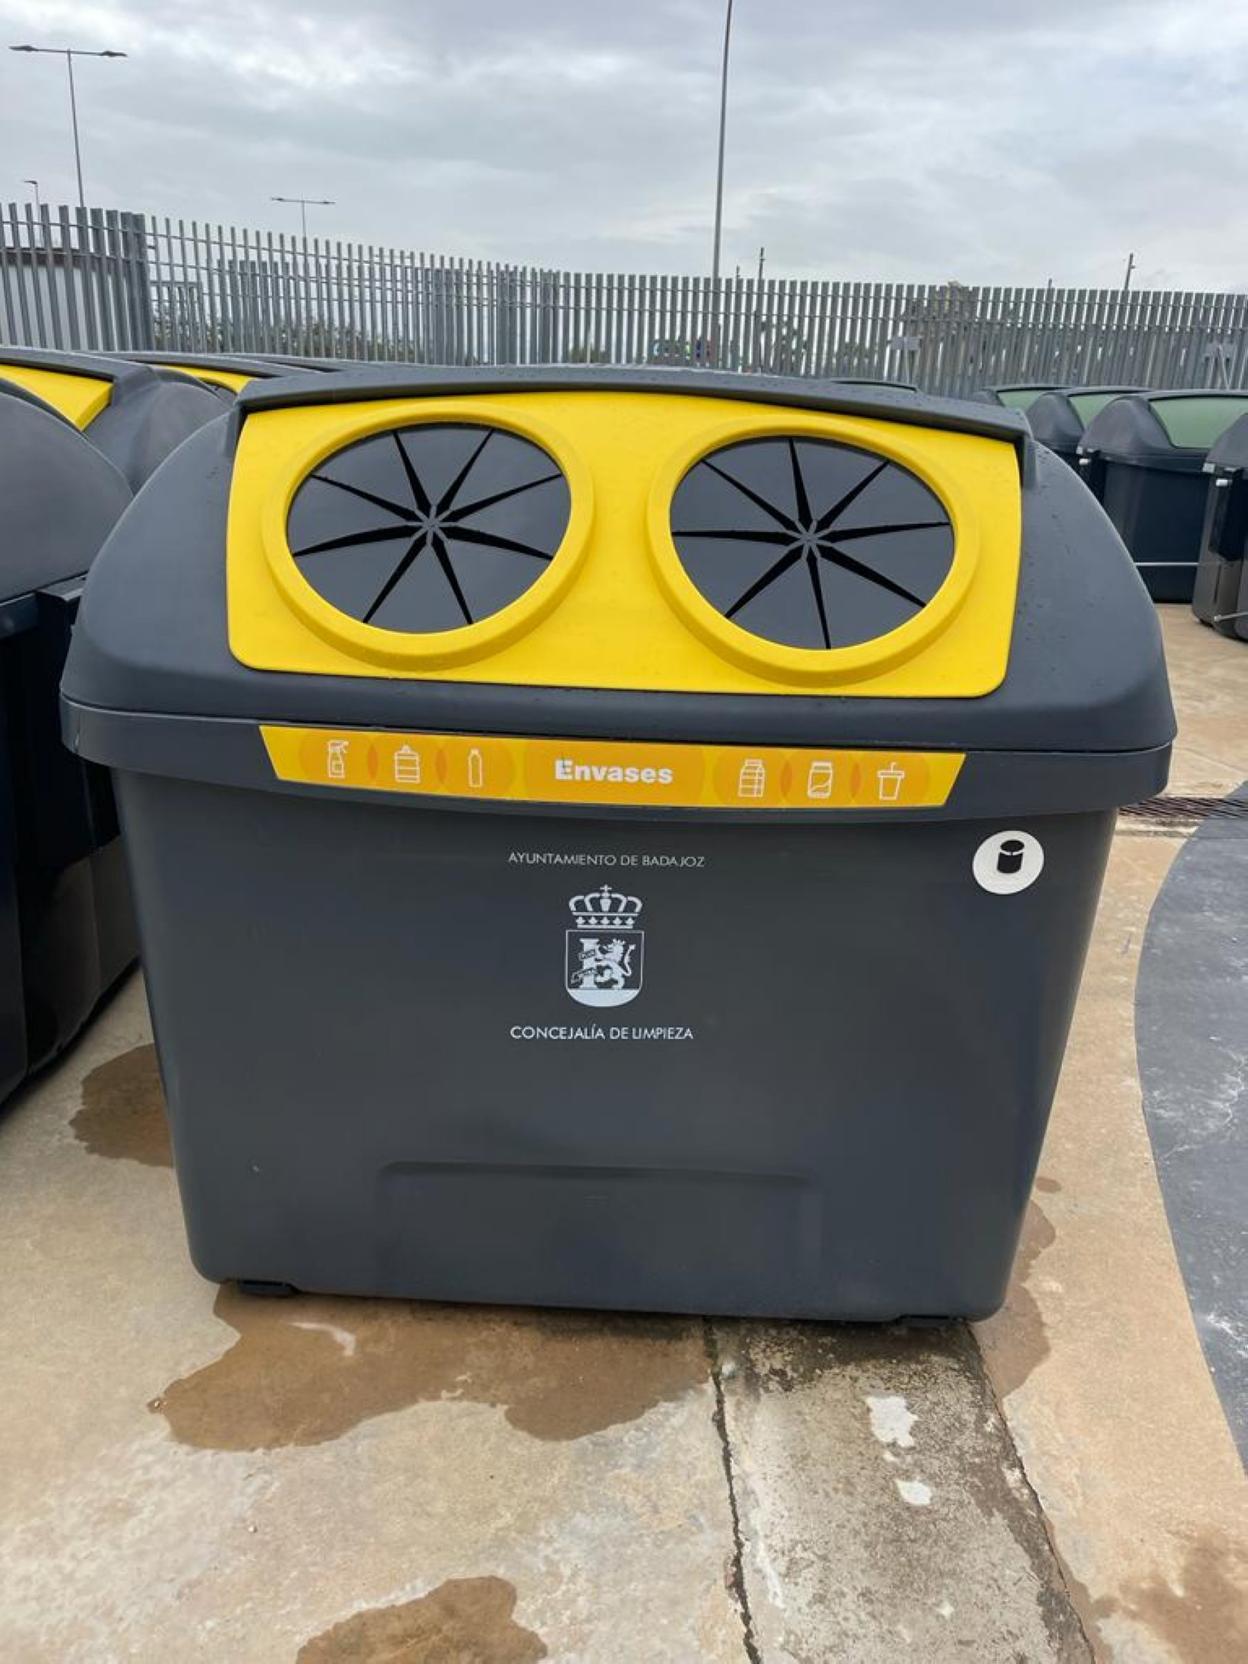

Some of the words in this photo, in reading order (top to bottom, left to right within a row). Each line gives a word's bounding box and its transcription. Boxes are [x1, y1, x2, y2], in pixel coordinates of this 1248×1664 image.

[555, 759, 673, 784] Envases
[508, 852, 616, 867] AYUNTAMIENTO
[620, 854, 639, 867] DE
[642, 854, 705, 868] BADAJOZ
[510, 1024, 606, 1040] CONCEJALÍA
[609, 1026, 629, 1040] DE
[632, 1026, 694, 1040] LIMPIEZA
